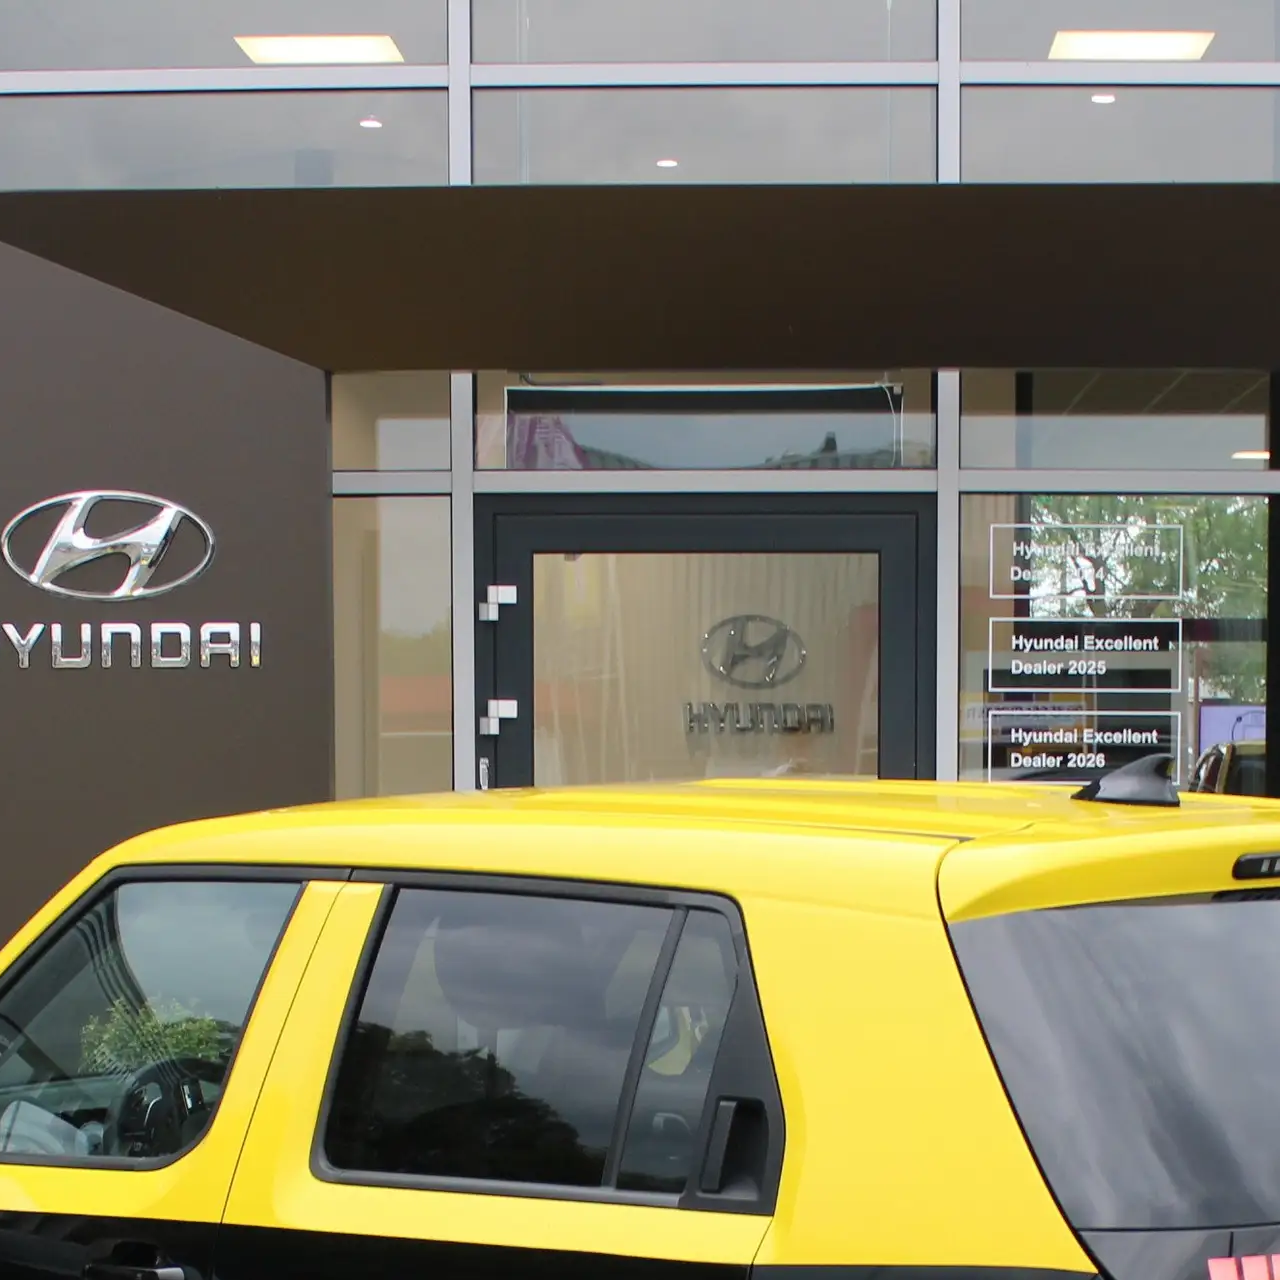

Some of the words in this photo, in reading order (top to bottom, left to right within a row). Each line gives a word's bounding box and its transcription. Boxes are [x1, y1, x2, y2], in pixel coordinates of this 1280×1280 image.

[1011, 635, 1079, 653] Hyundai
[1083, 635, 1160, 651] Excellent
[1011, 660, 1064, 676] Dealer
[1068, 660, 1107, 676] 2025
[683, 702, 835, 733] HYUNDAI
[1010, 728, 1078, 747] Hyundai
[1083, 728, 1159, 744] Excellent
[1010, 752, 1063, 768] Dealer
[1067, 752, 1106, 768] 2026
